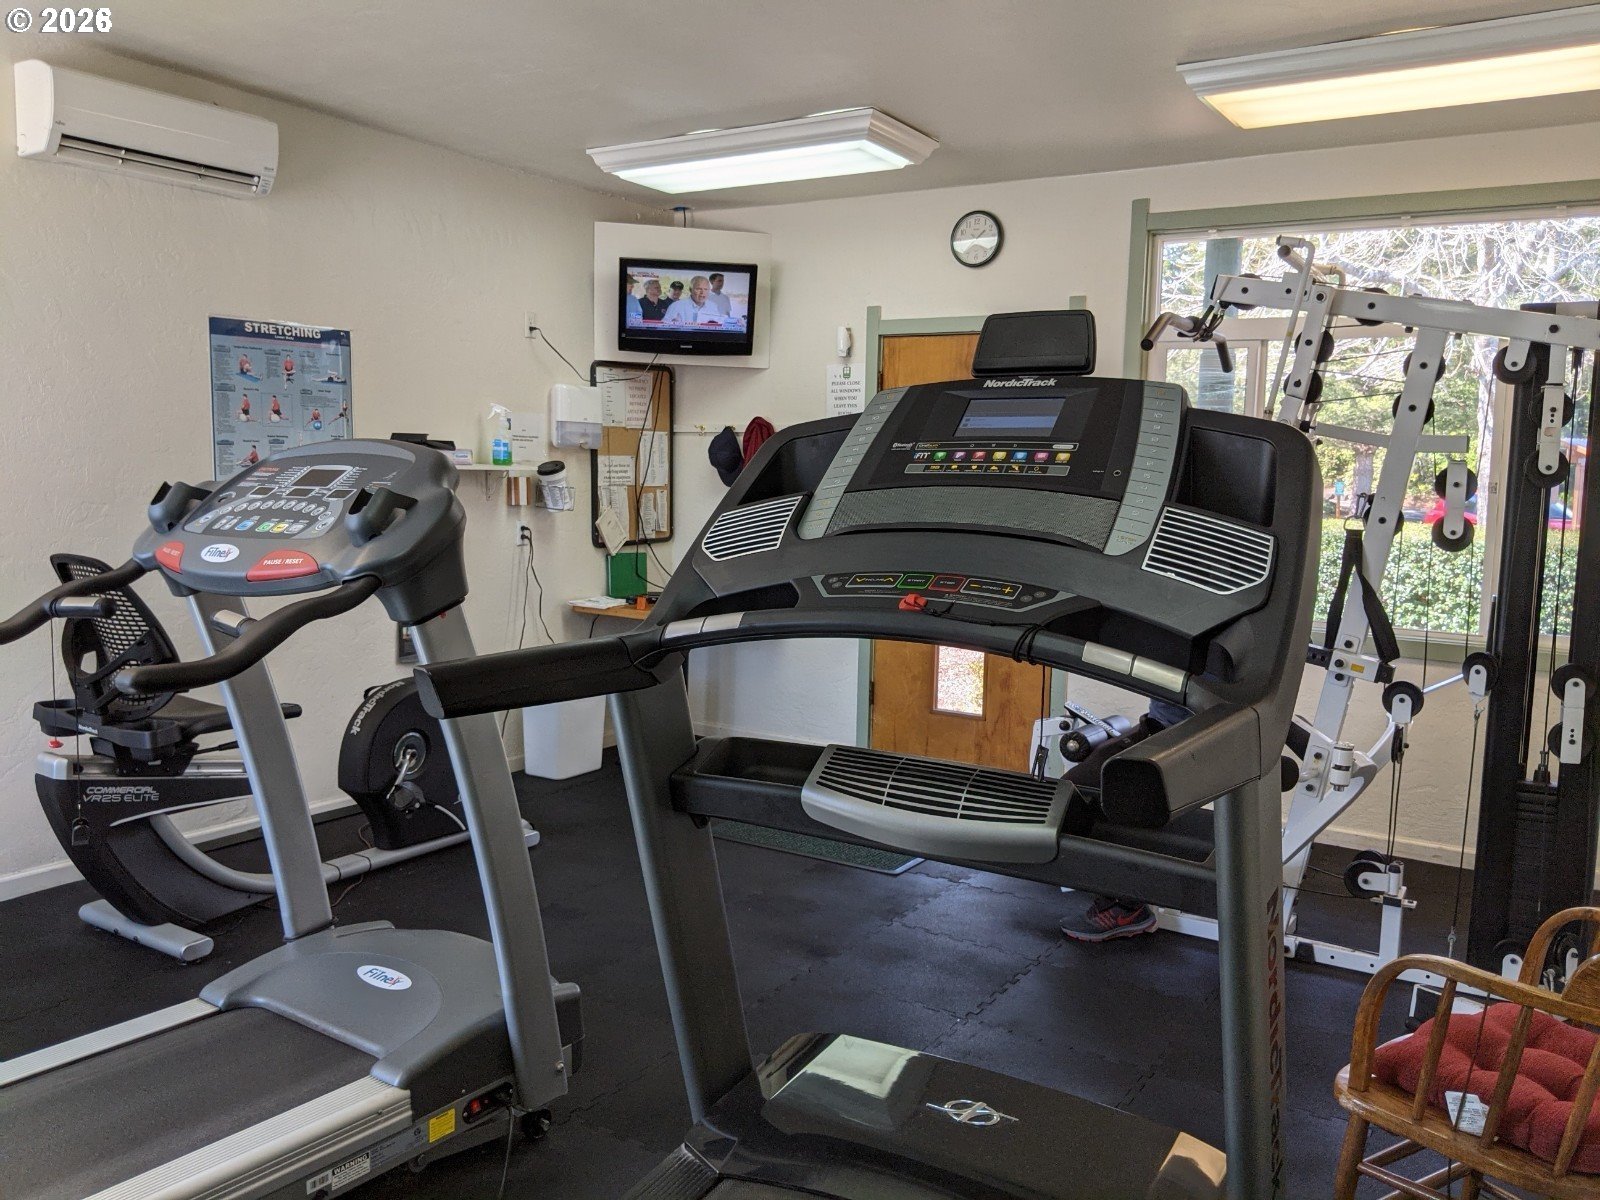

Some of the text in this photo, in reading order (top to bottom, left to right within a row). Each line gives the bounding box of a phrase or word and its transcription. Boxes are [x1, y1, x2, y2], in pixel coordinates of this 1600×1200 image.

[244, 322, 321, 339] STRETCHING
[983, 377, 1058, 388] NordicTrack
[263, 558, 282, 566] PAUSE
[286, 557, 304, 565] RESET
[350, 681, 405, 736] NordicTrack
[86, 785, 157, 794] COMMERCIAL
[123, 792, 160, 802] ELITE
[1266, 887, 1284, 1197] NordicTrack
[333, 1152, 368, 1175] WARNING
